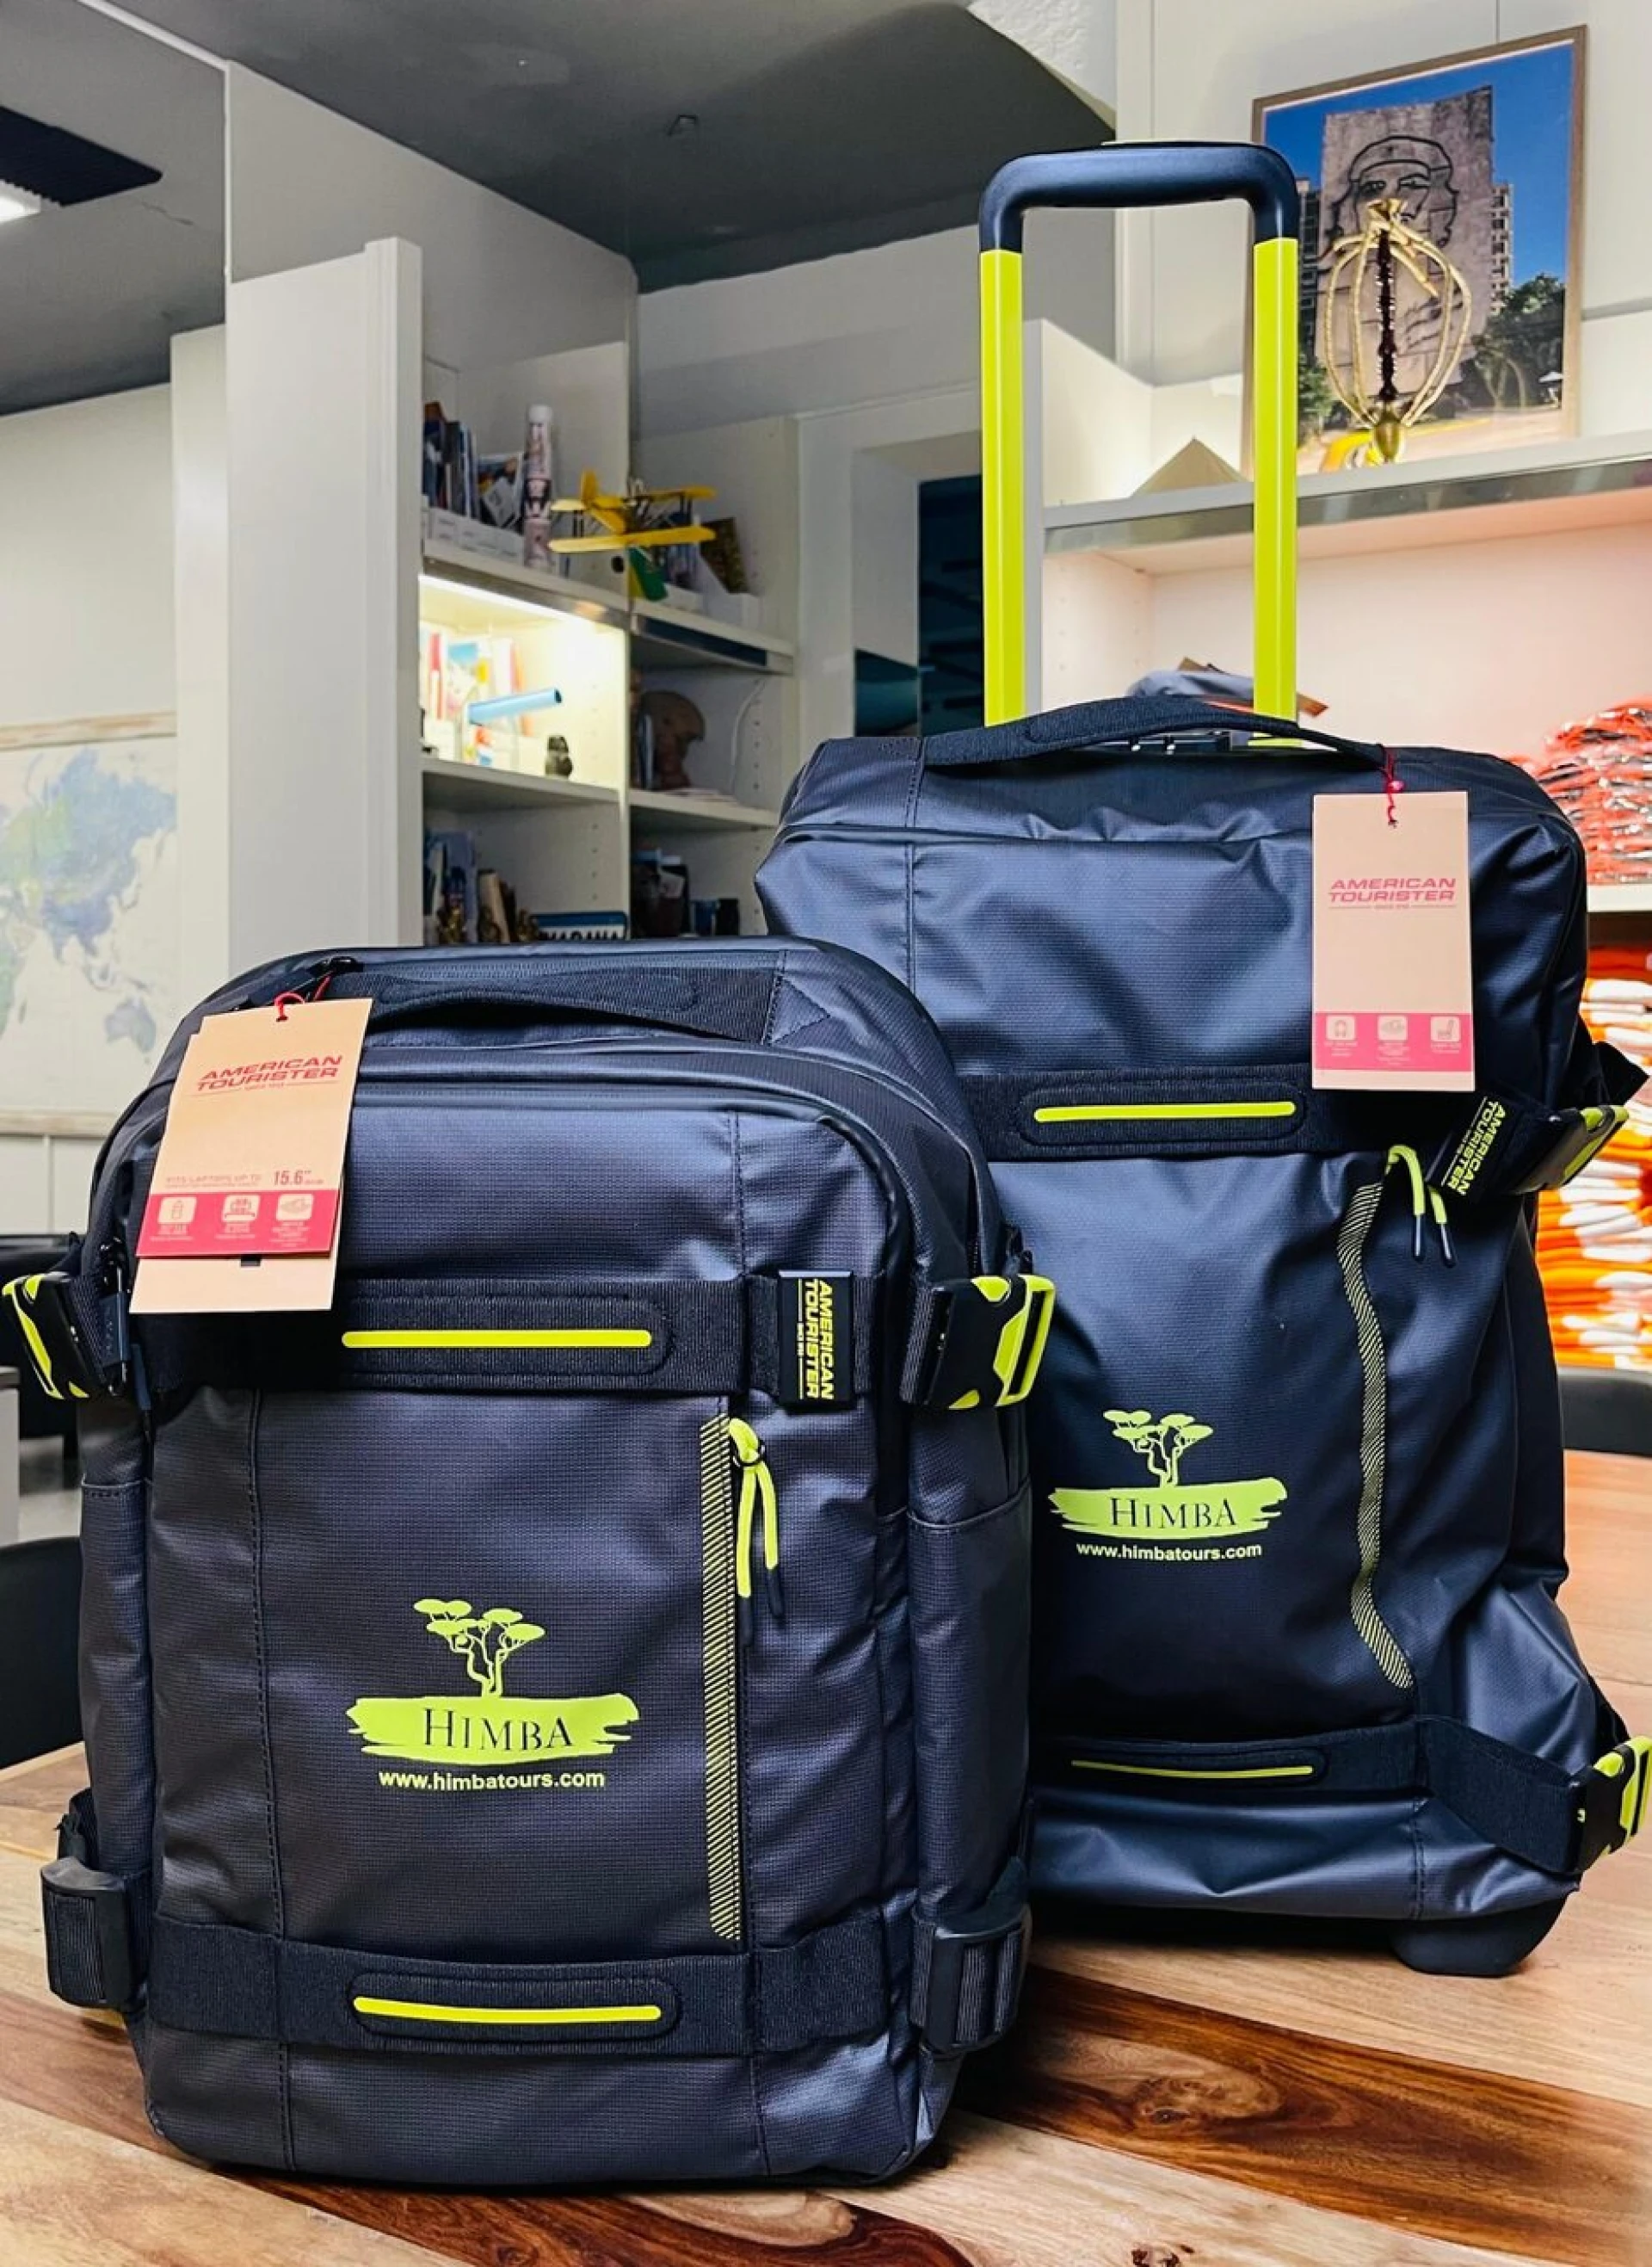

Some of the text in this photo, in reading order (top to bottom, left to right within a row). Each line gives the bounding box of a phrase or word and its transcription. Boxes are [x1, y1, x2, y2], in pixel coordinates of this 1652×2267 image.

[1328, 891, 1455, 902] TOURISTER
[1331, 878, 1456, 890] AMERICAN
[198, 1067, 338, 1091] TOURISTER
[200, 1055, 342, 1081] AMERICAN
[1446, 1102, 1499, 1189] TOURISTER
[1457, 1105, 1506, 1195] AMERICAN
[804, 1278, 819, 1399] TOURISTER
[820, 1280, 834, 1399] AMERICAN
[1109, 1498, 1236, 1529] HIMBA
[1076, 1543, 1263, 1561] www.himbatours.com
[424, 1708, 573, 1751] HIMBA
[379, 1771, 605, 1791] www.himbatours.com
